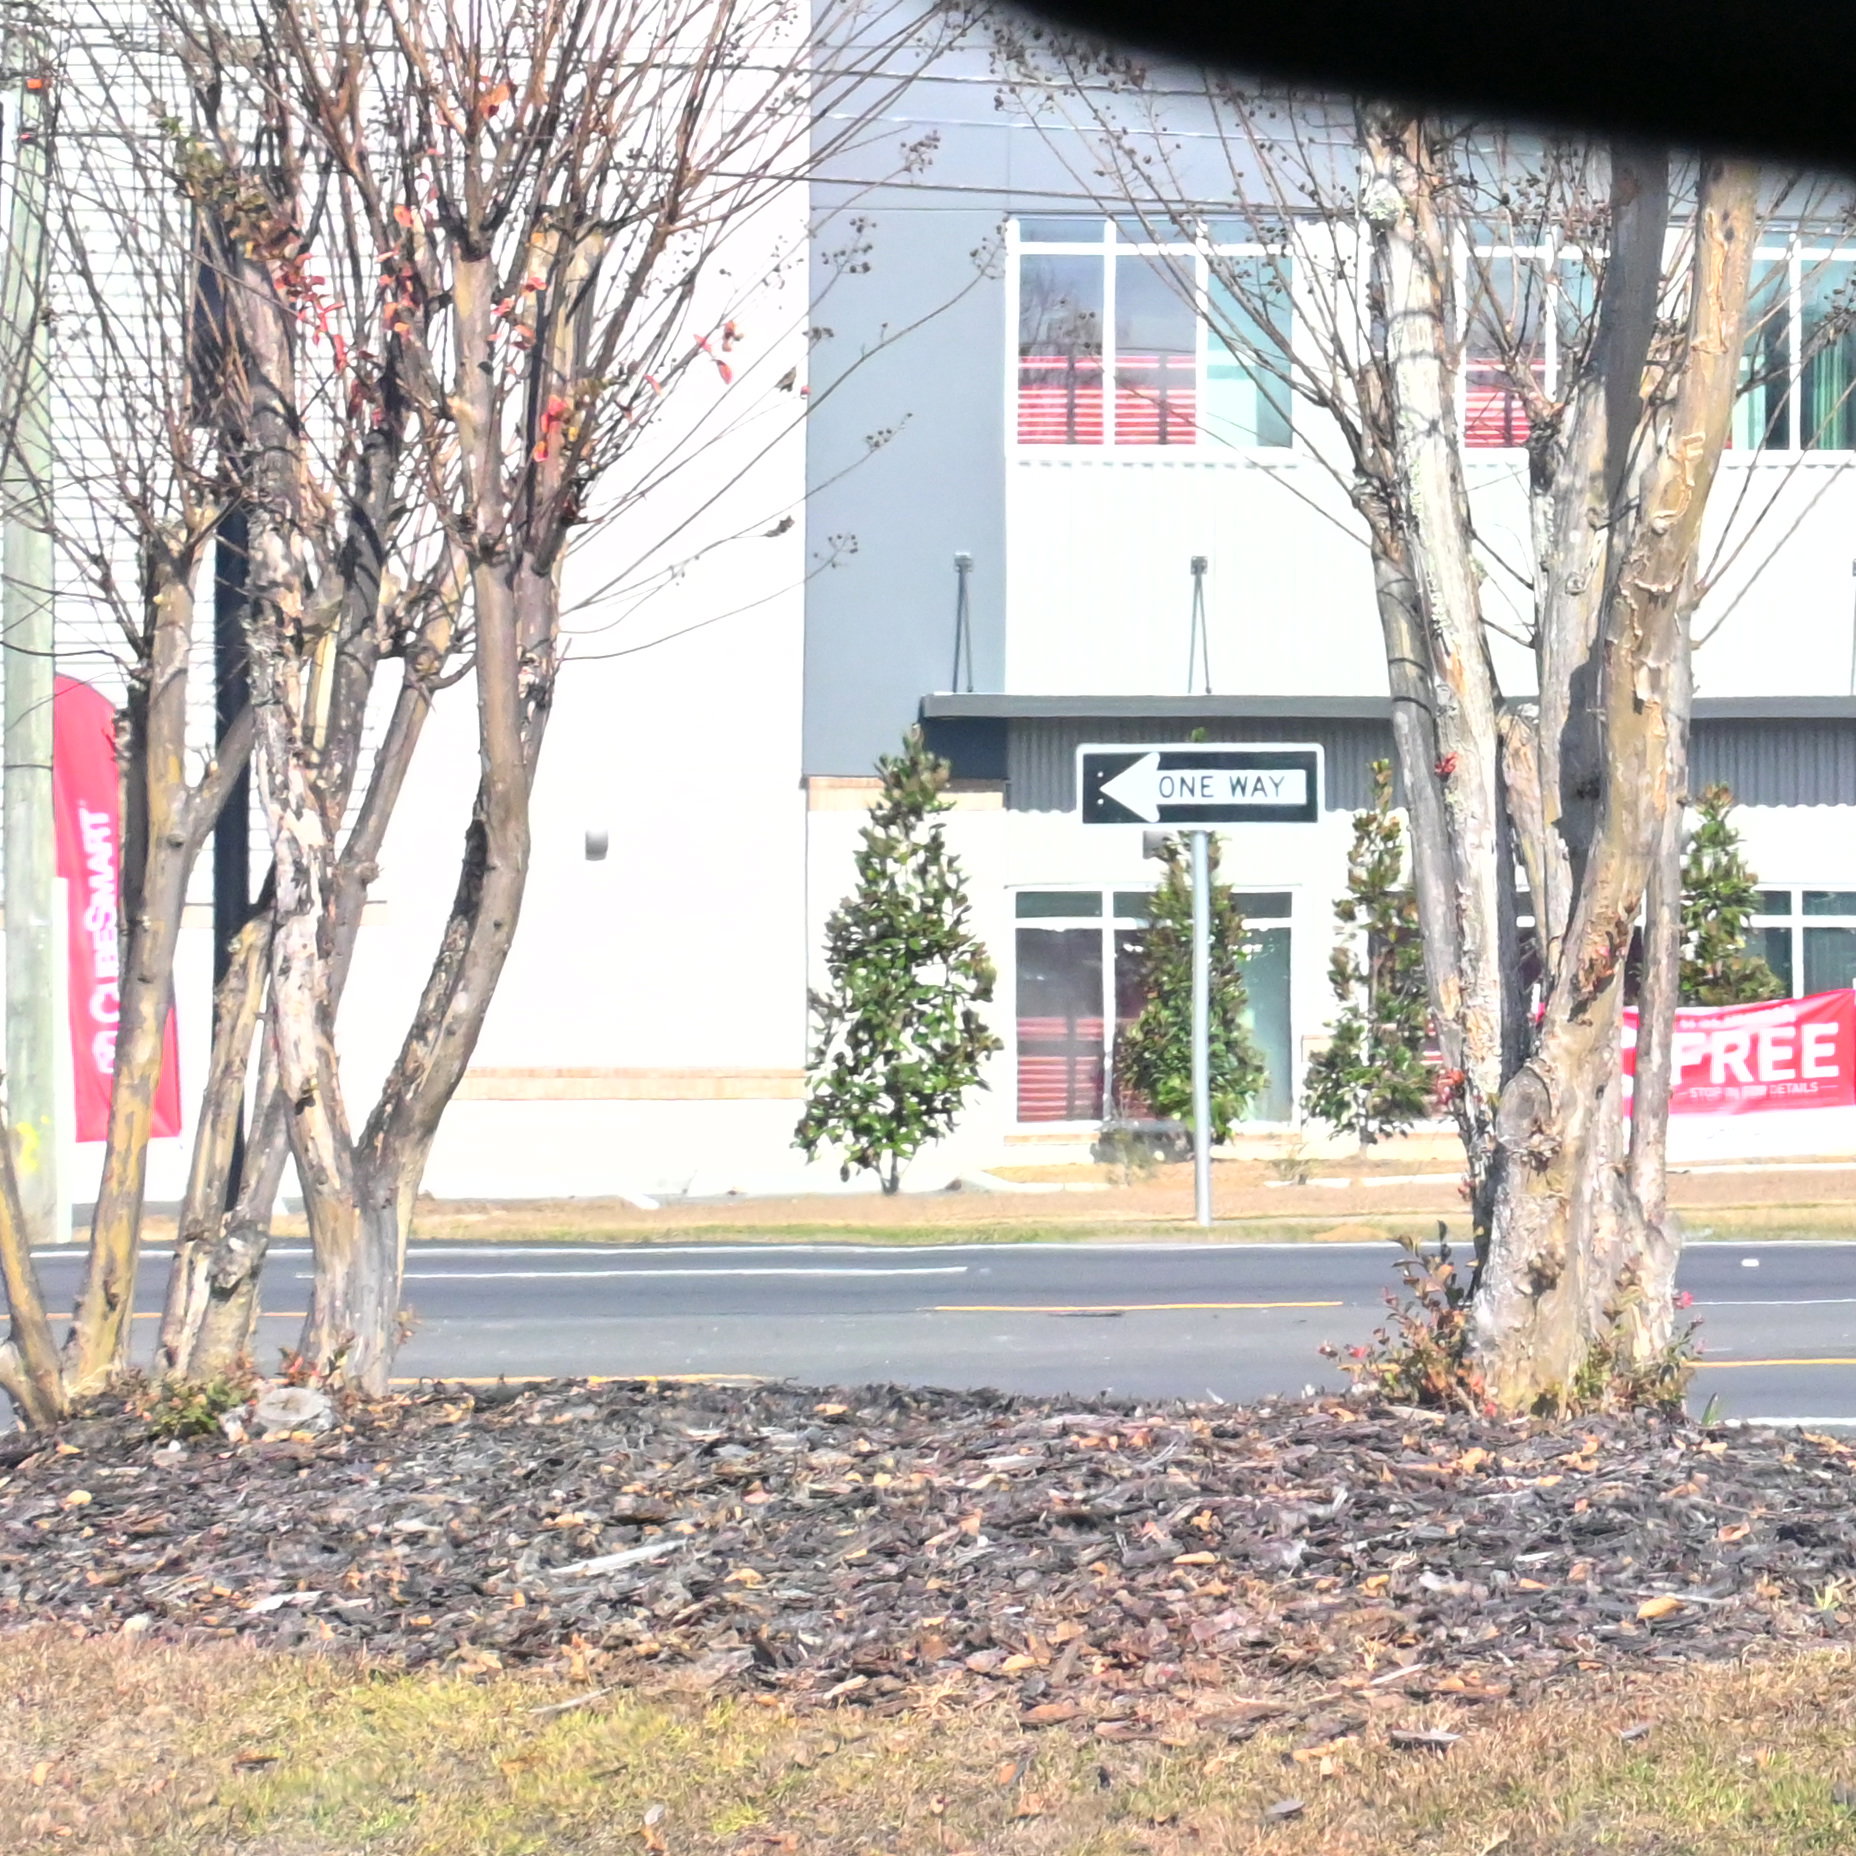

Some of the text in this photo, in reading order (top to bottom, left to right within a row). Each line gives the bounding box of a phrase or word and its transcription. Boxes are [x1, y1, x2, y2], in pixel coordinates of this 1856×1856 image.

[1159, 775, 1286, 798] ONE WAY
[1670, 1022, 1840, 1085] FREE
